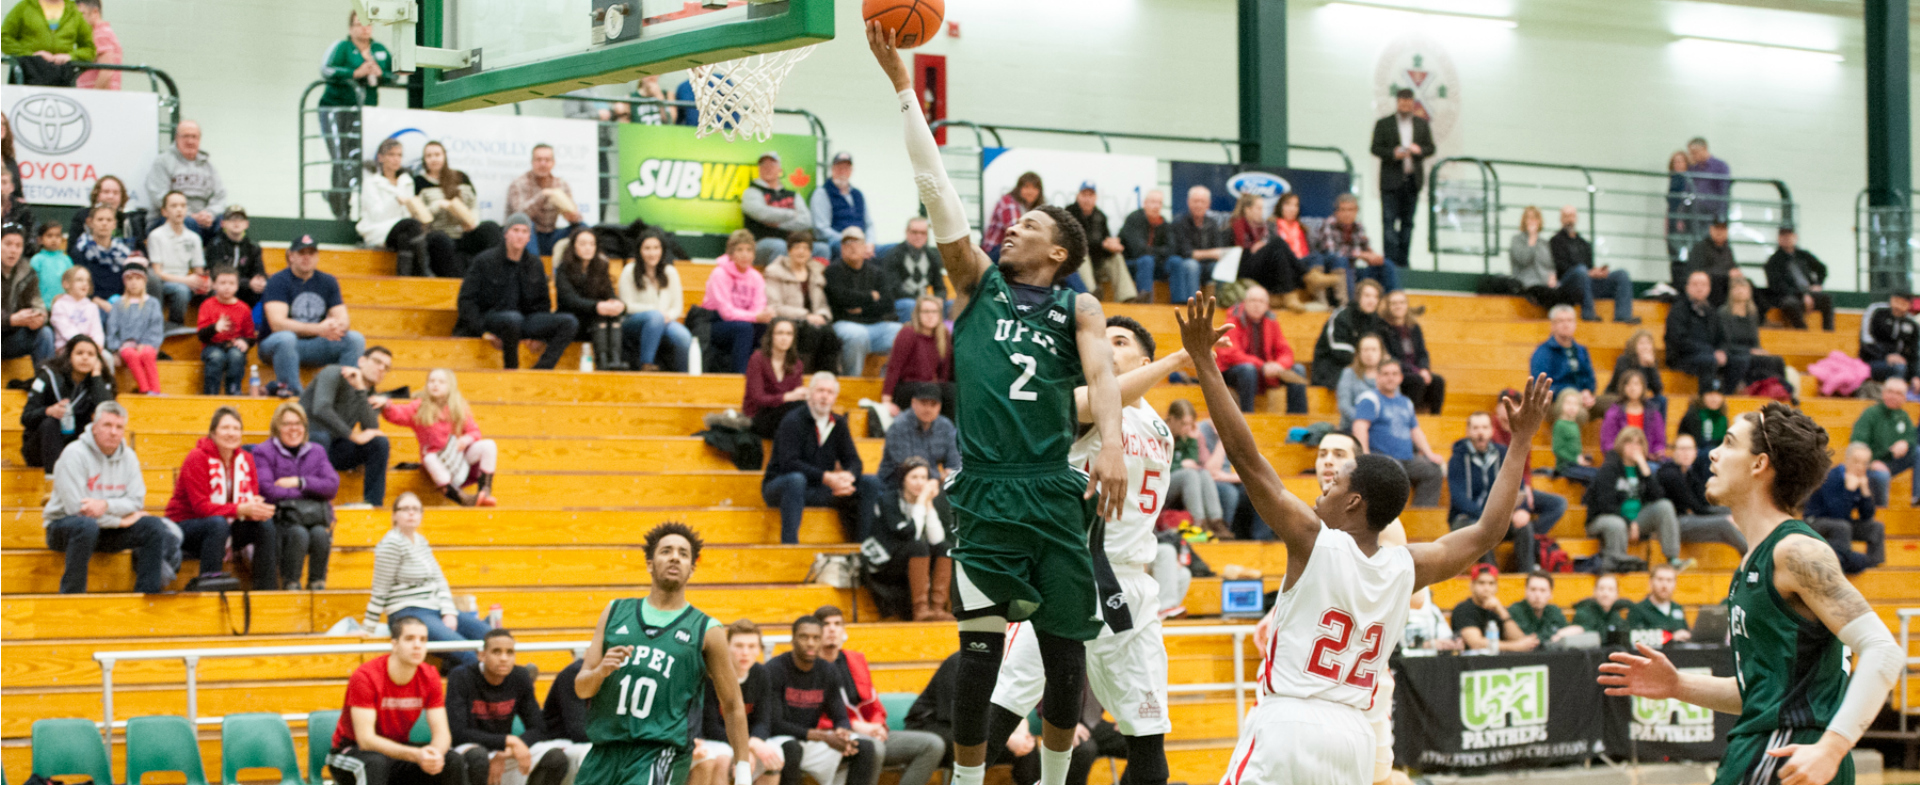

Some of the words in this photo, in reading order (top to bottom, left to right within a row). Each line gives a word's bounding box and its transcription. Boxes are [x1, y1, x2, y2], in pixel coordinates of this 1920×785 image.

[19, 161, 98, 182] OYOTA
[1009, 352, 1038, 401] 2
[1138, 468, 1162, 516] 5
[1303, 606, 1386, 692] 22
[616, 674, 658, 719] 10
[1461, 725, 1549, 750] PANTHERS
